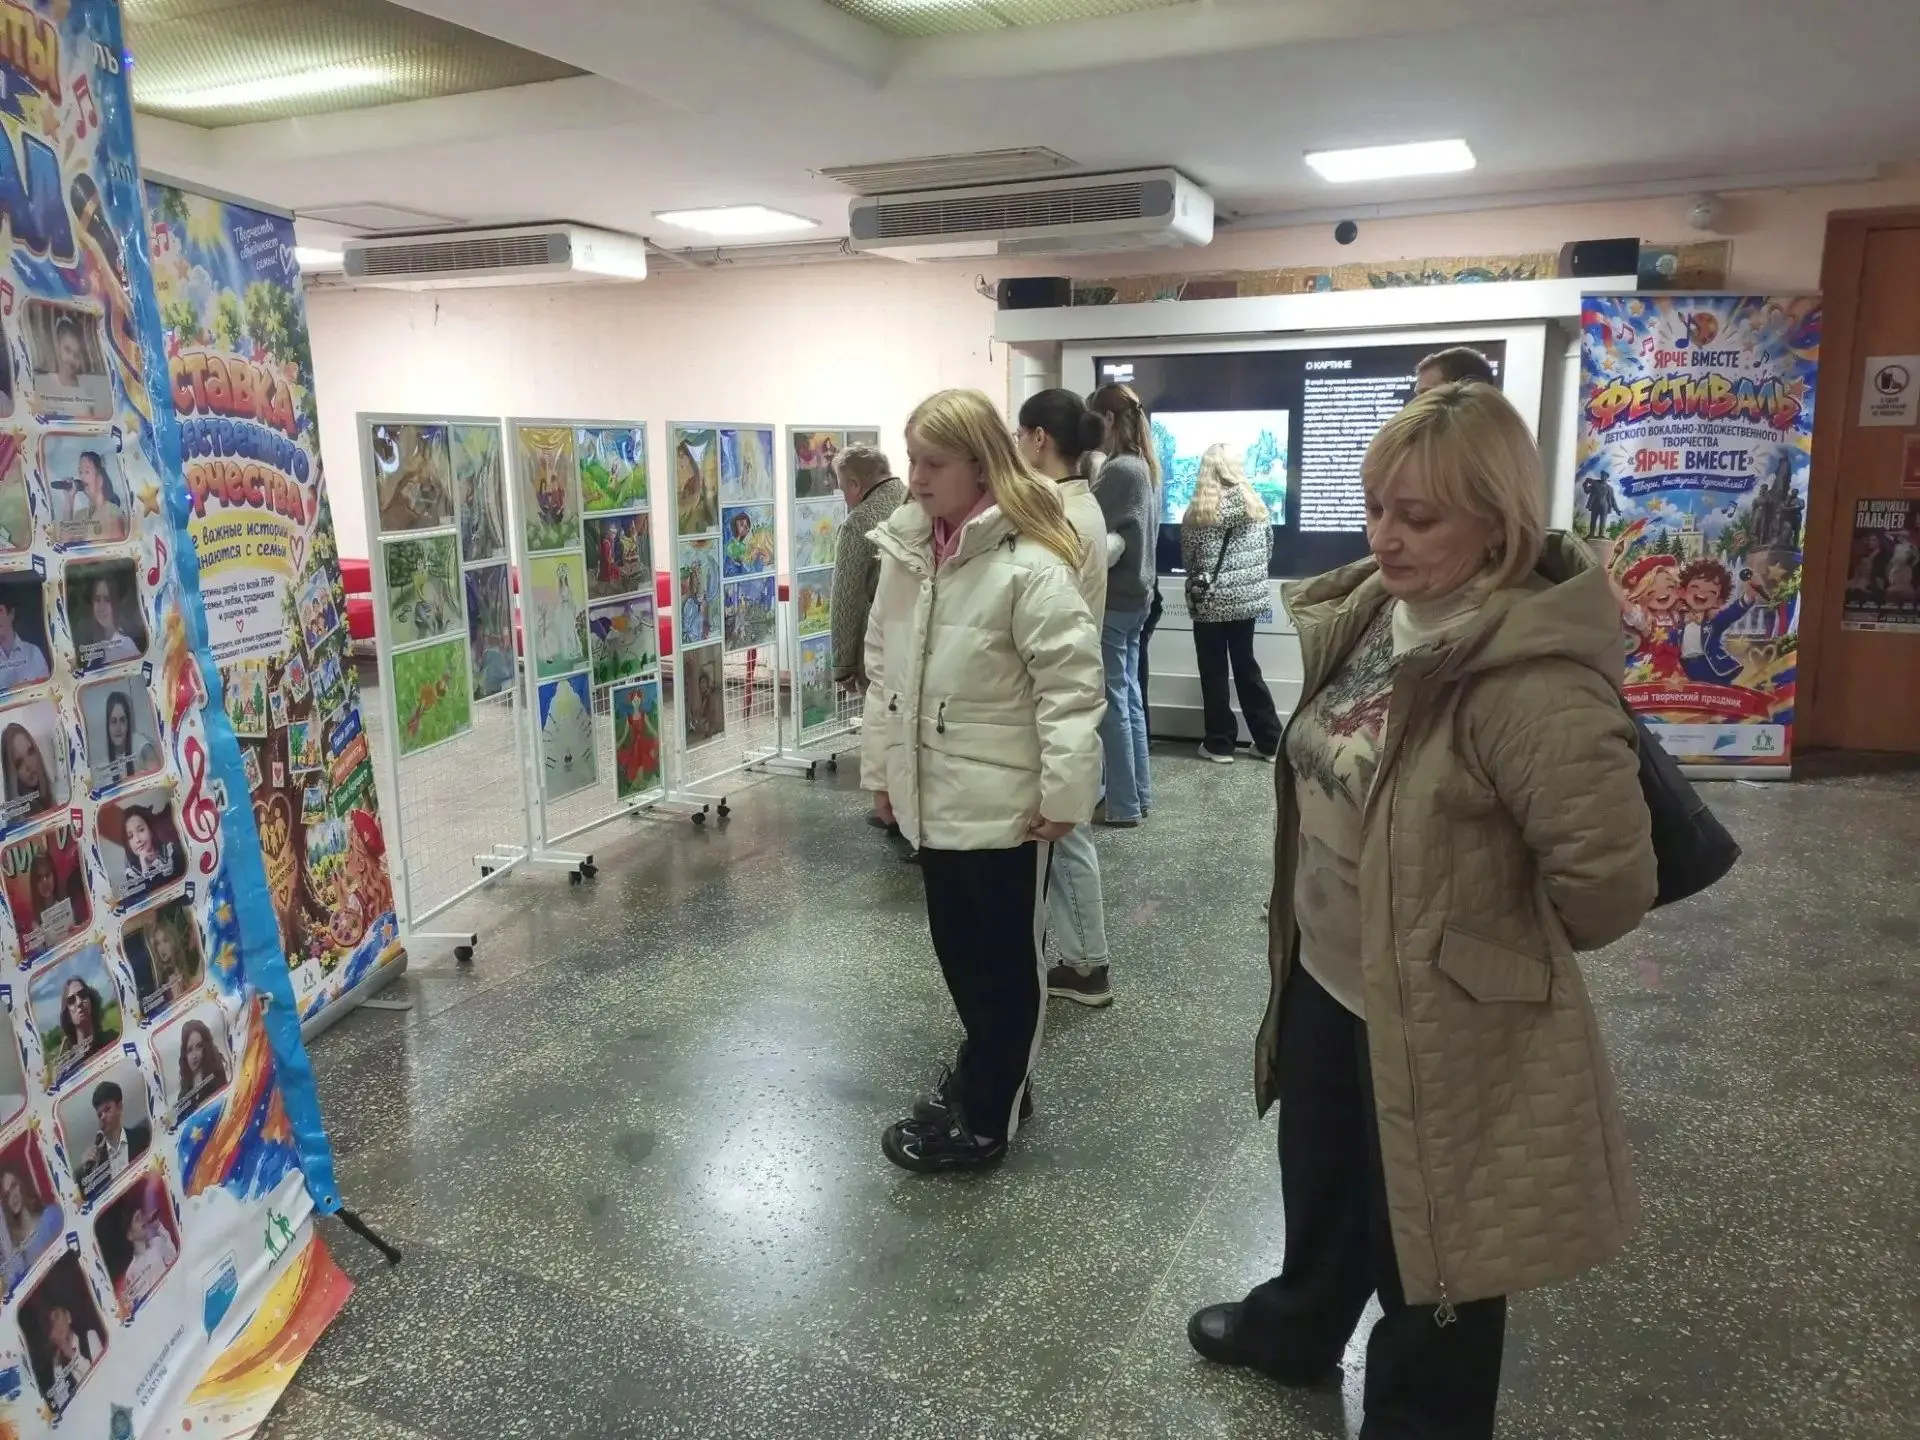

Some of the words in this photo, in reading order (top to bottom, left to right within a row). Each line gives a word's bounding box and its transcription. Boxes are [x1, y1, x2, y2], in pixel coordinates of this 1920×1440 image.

[1653, 350, 1688, 368] ЯРЧЕ
[1691, 350, 1739, 368] ВМЕСТЕ
[1590, 373, 1801, 428] ФЕСТИВАЛЬ
[1604, 426, 1646, 445] ДЕТСКОГО
[1648, 423, 1777, 442] ВОКАЛЬНО-ХУДОЖЕСТВЕННОГО
[1663, 436, 1719, 448] ТВОРЧЕСТВА
[1856, 512, 1905, 530] ПАЛЬЦЕВ
[203, 523, 242, 545] важные
[247, 523, 288, 541] истории
[245, 544, 252, 556] с
[257, 543, 286, 557] семьи
[239, 583, 245, 591] со
[260, 576, 275, 588] ЛНР
[1651, 691, 1699, 704] творческий
[1701, 694, 1742, 708] праздник
